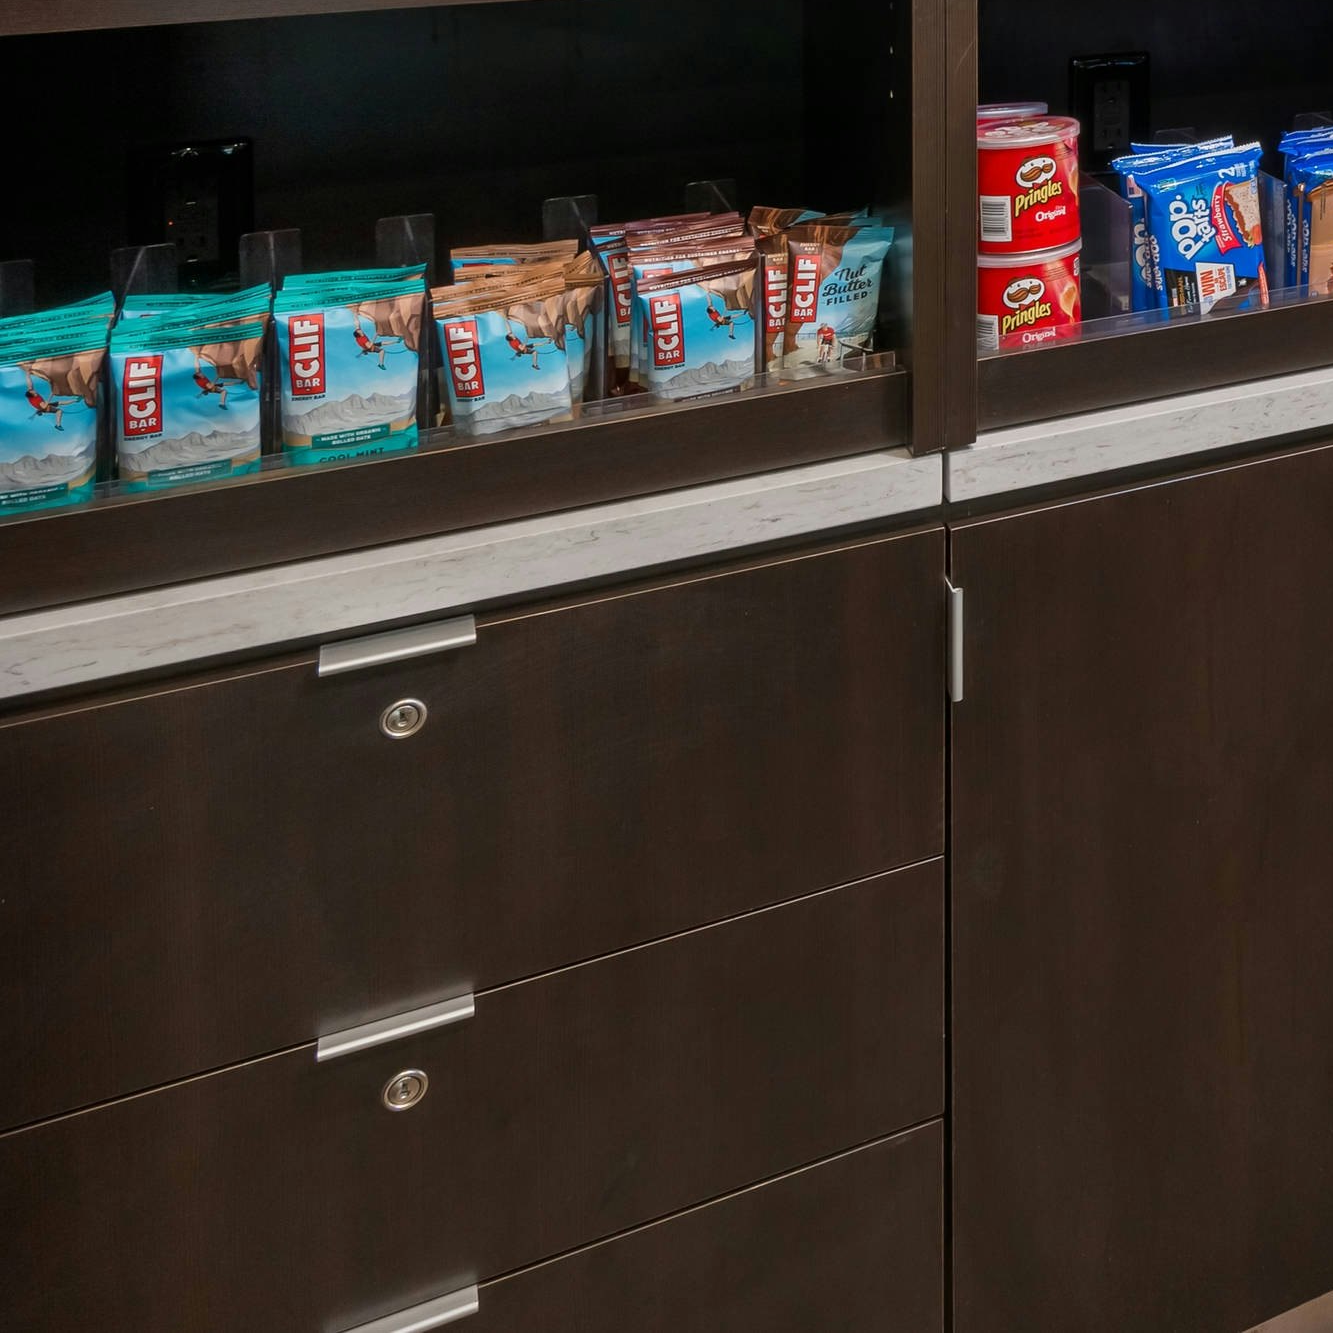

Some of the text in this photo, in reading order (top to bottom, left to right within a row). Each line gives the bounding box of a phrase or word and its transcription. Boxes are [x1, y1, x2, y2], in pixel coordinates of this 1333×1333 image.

[1015, 180, 1062, 217] Pringles
[1215, 195, 1232, 242] Strawberry
[795, 259, 816, 308] CLIF
[837, 266, 866, 281] Nut
[822, 278, 873, 297] Butter
[826, 291, 868, 306] FILLED
[656, 300, 680, 347] CLIF
[794, 308, 813, 317] BAR
[1002, 301, 1051, 335] Pringles
[294, 319, 320, 378] CLIF
[449, 326, 478, 382] CLIF
[658, 350, 680, 360] BAR
[129, 362, 157, 420] CLIF
[295, 377, 321, 389] BAR
[457, 380, 480, 393] BAR
[129, 416, 157, 429] BAR
